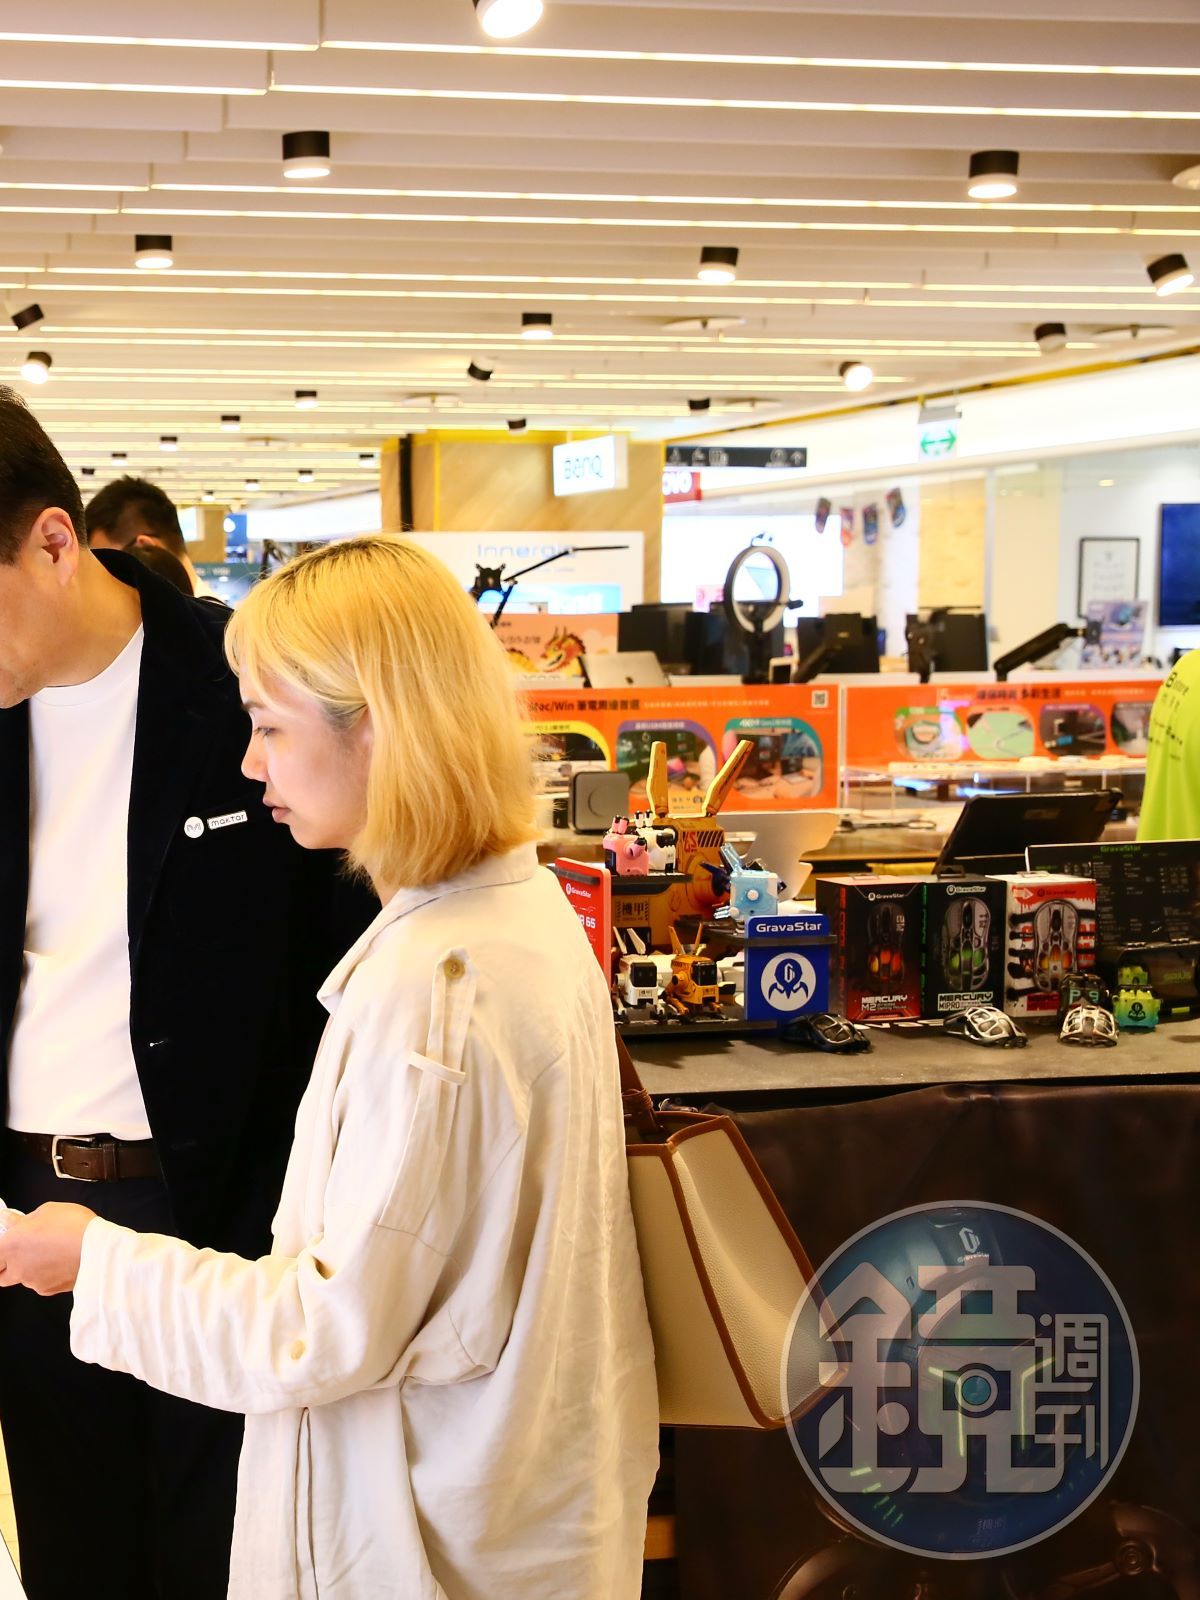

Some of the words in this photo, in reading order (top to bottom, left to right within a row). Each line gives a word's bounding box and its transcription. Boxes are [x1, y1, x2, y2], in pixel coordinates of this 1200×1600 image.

[756, 922, 822, 933] GravaStar
[861, 995, 908, 1003] MERCURY
[939, 993, 992, 1001] MERCURY
